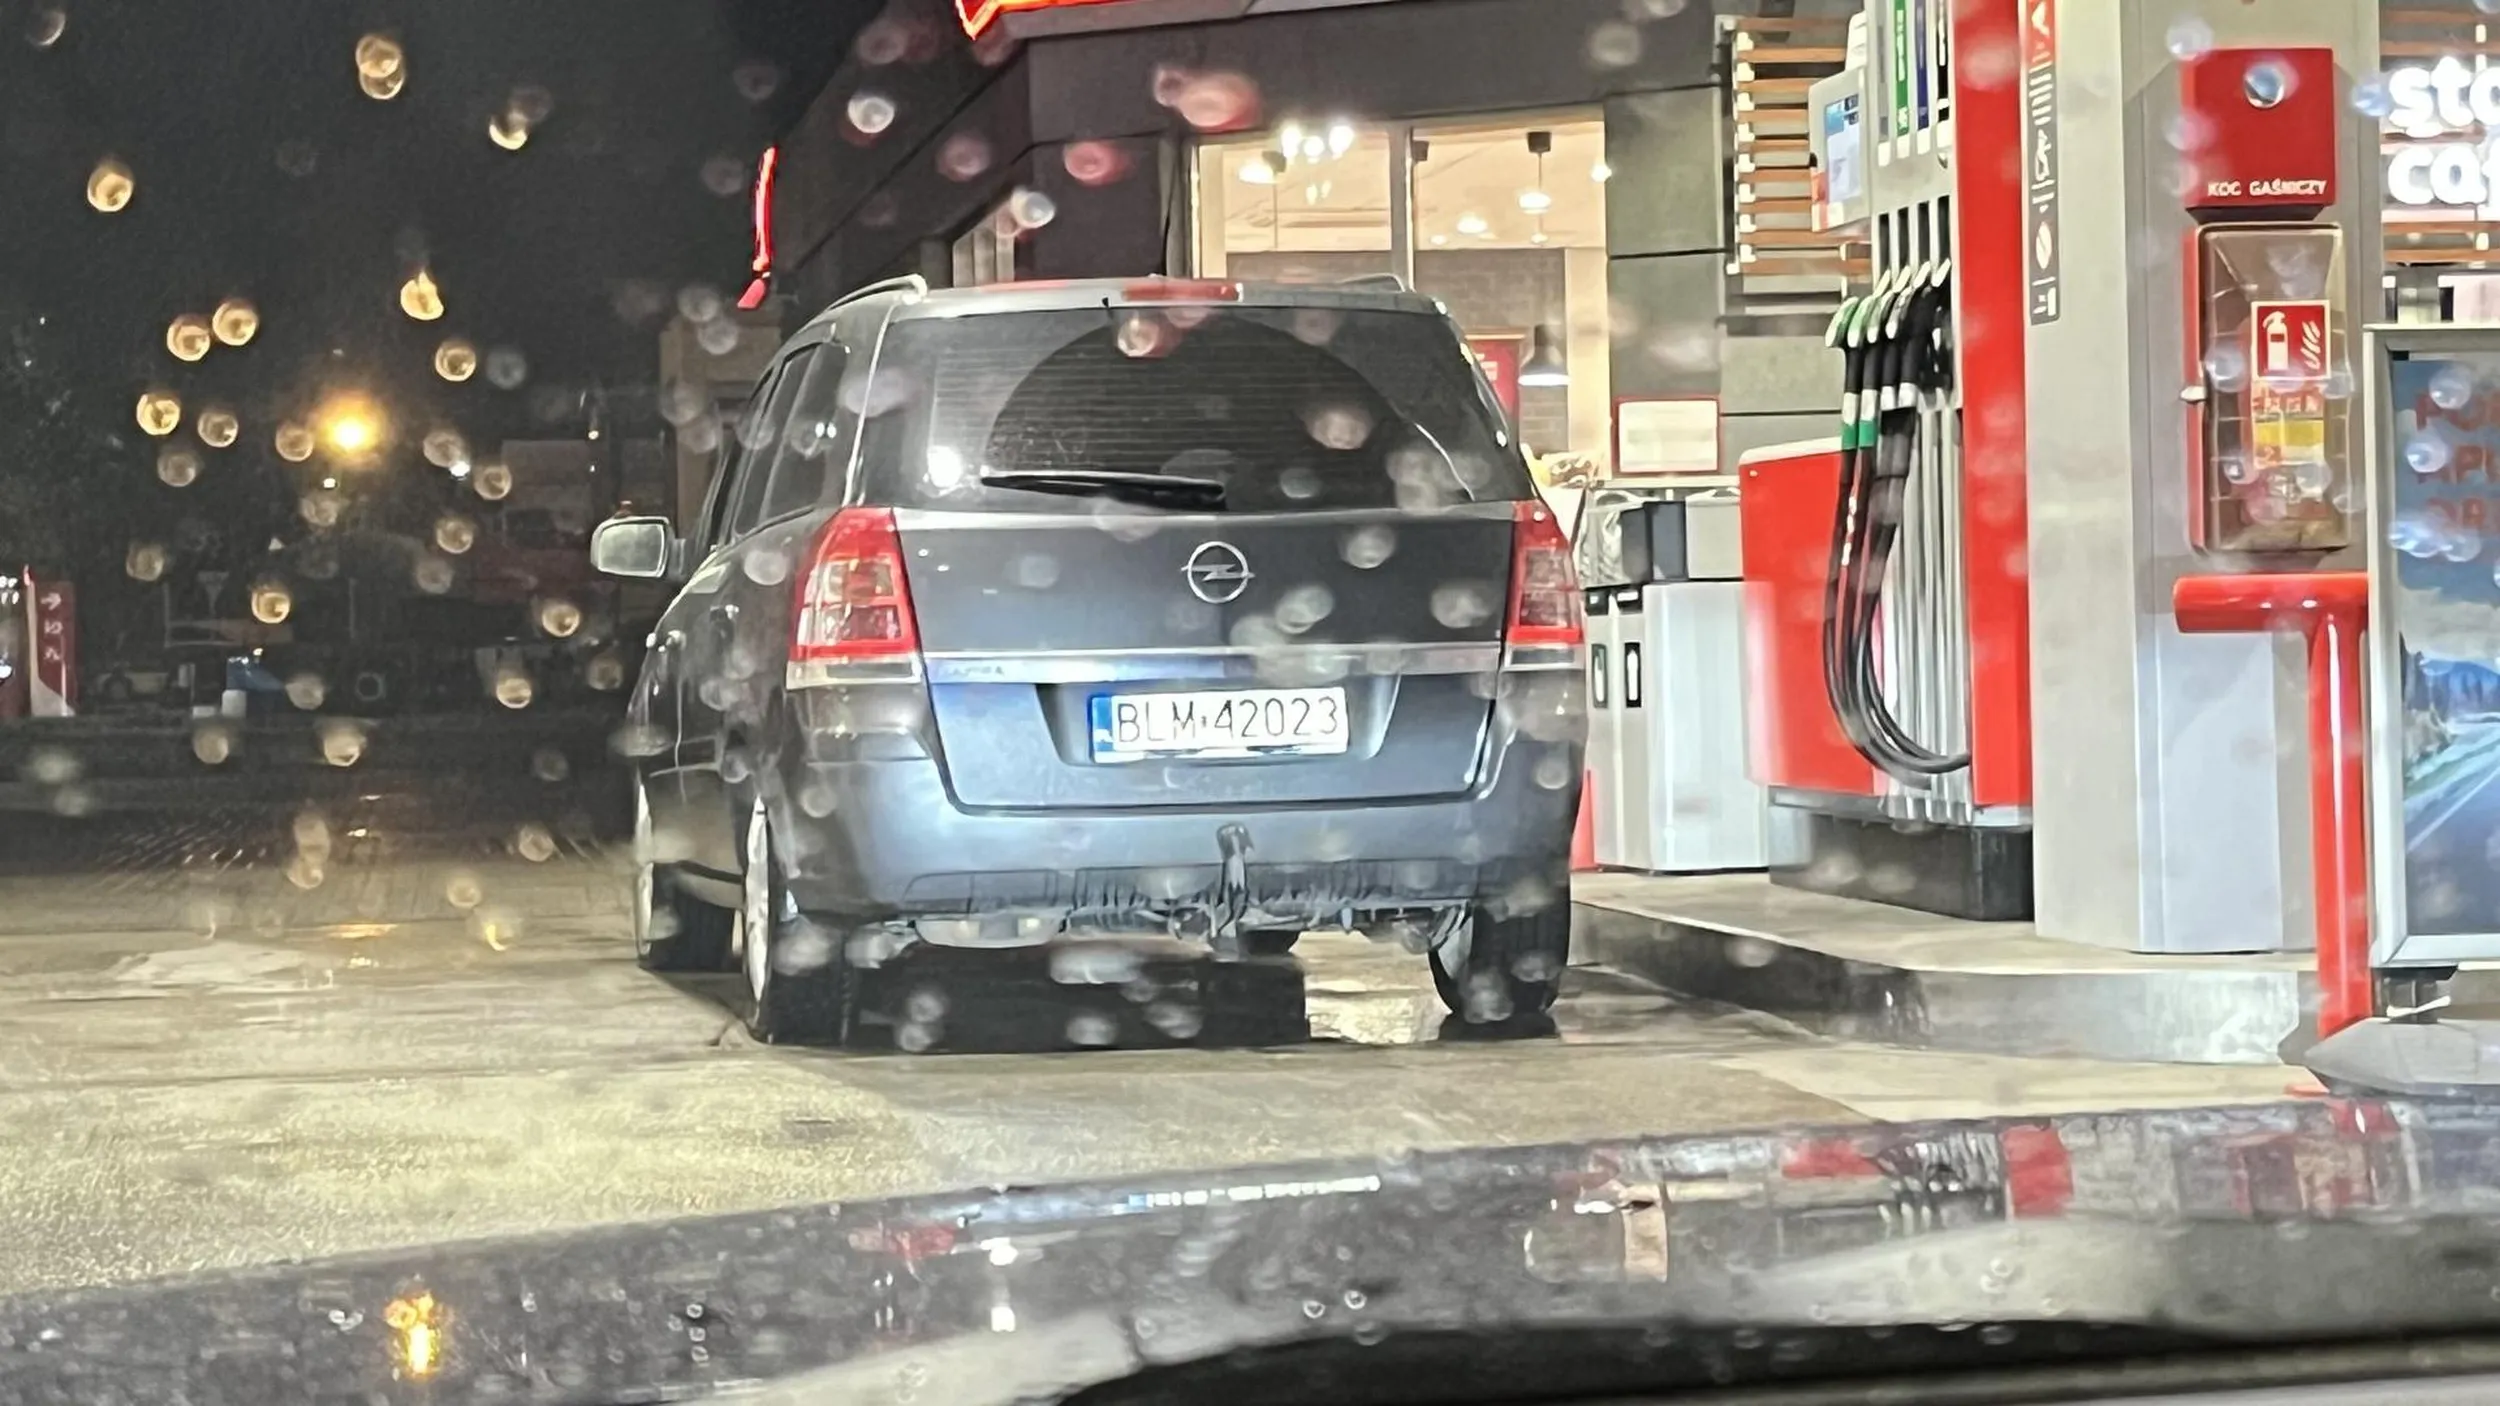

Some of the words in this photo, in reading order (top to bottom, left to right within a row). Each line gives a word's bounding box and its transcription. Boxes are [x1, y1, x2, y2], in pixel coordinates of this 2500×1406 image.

[2207, 180, 2242, 197] KOC
[1117, 699, 1197, 743] BLM
[1213, 695, 1339, 740] 42023
